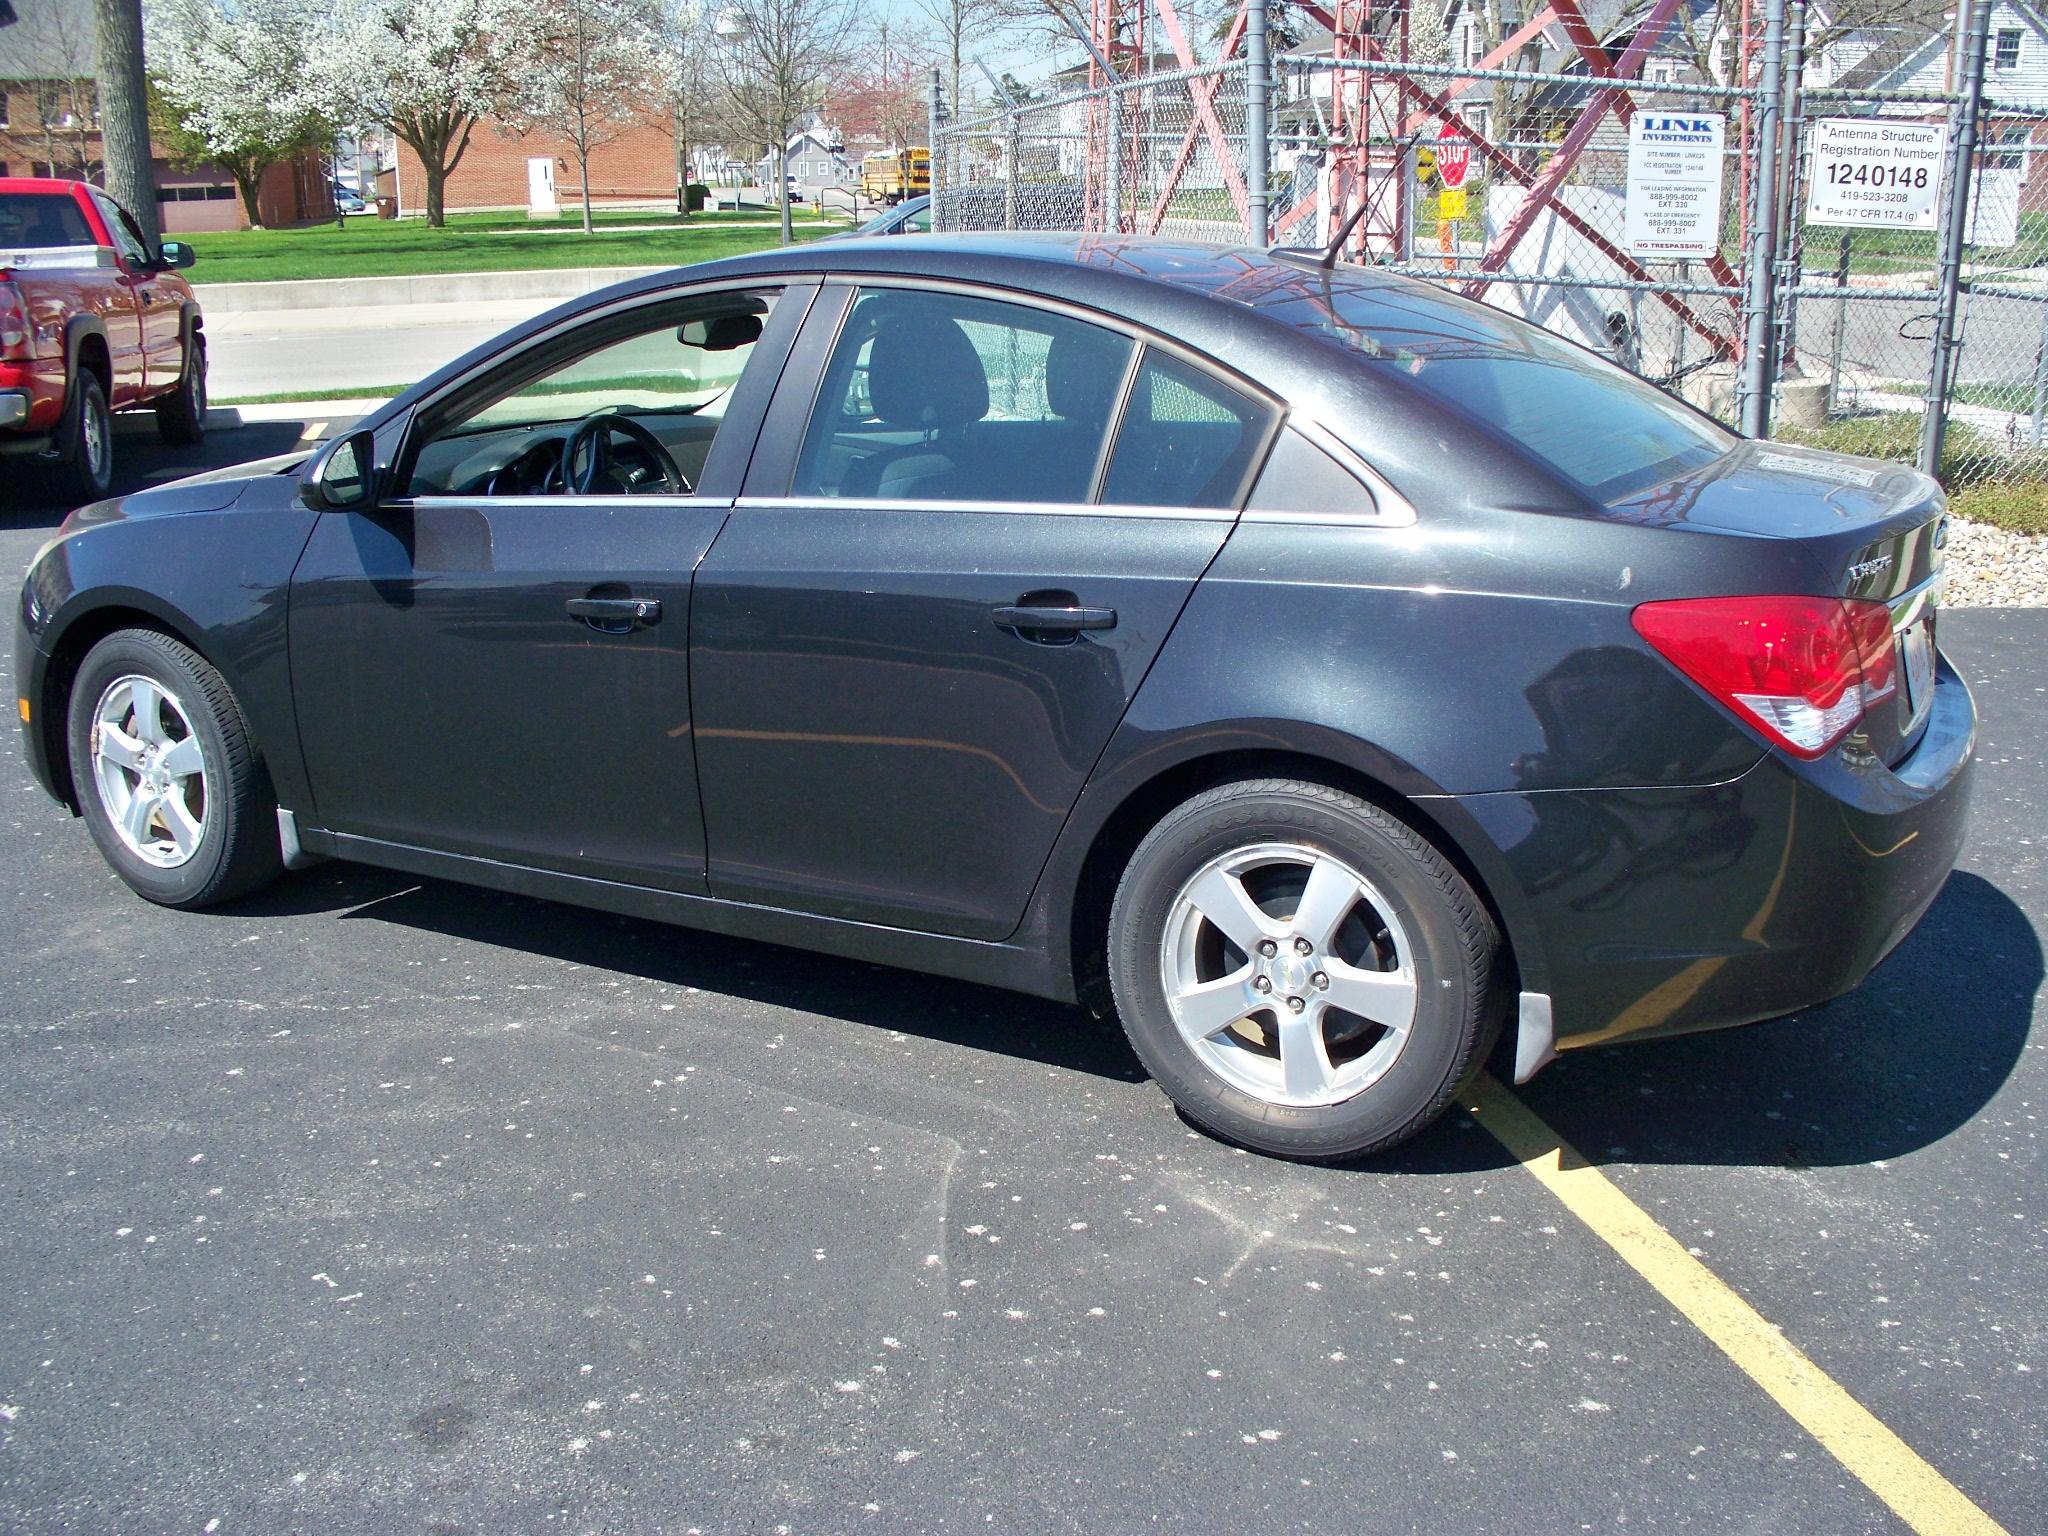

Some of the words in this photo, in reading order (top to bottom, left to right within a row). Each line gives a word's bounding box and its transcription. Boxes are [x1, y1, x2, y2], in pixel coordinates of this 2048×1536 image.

[1642, 118, 1713, 132] LINK
[1642, 133, 1712, 143] INVESTMENTS
[1828, 127, 1877, 140] Antenna
[1881, 129, 1933, 144] Structure
[1440, 135, 1467, 166] STOP
[1820, 143, 1890, 158] Registration
[1893, 147, 1939, 160] Number
[1826, 162, 1928, 189] 1240148
[1649, 193, 1698, 201] 888-999-8002
[1840, 190, 1908, 203] 419-523-3208
[1827, 207, 1843, 217] Per
[1846, 208, 1857, 218] 47
[1860, 209, 1881, 219] CFR
[1884, 210, 1902, 220] 17.4
[1904, 211, 1918, 222] (g)
[1648, 219, 1697, 227] 888-999-8002
[1673, 227, 1686, 235] 331
